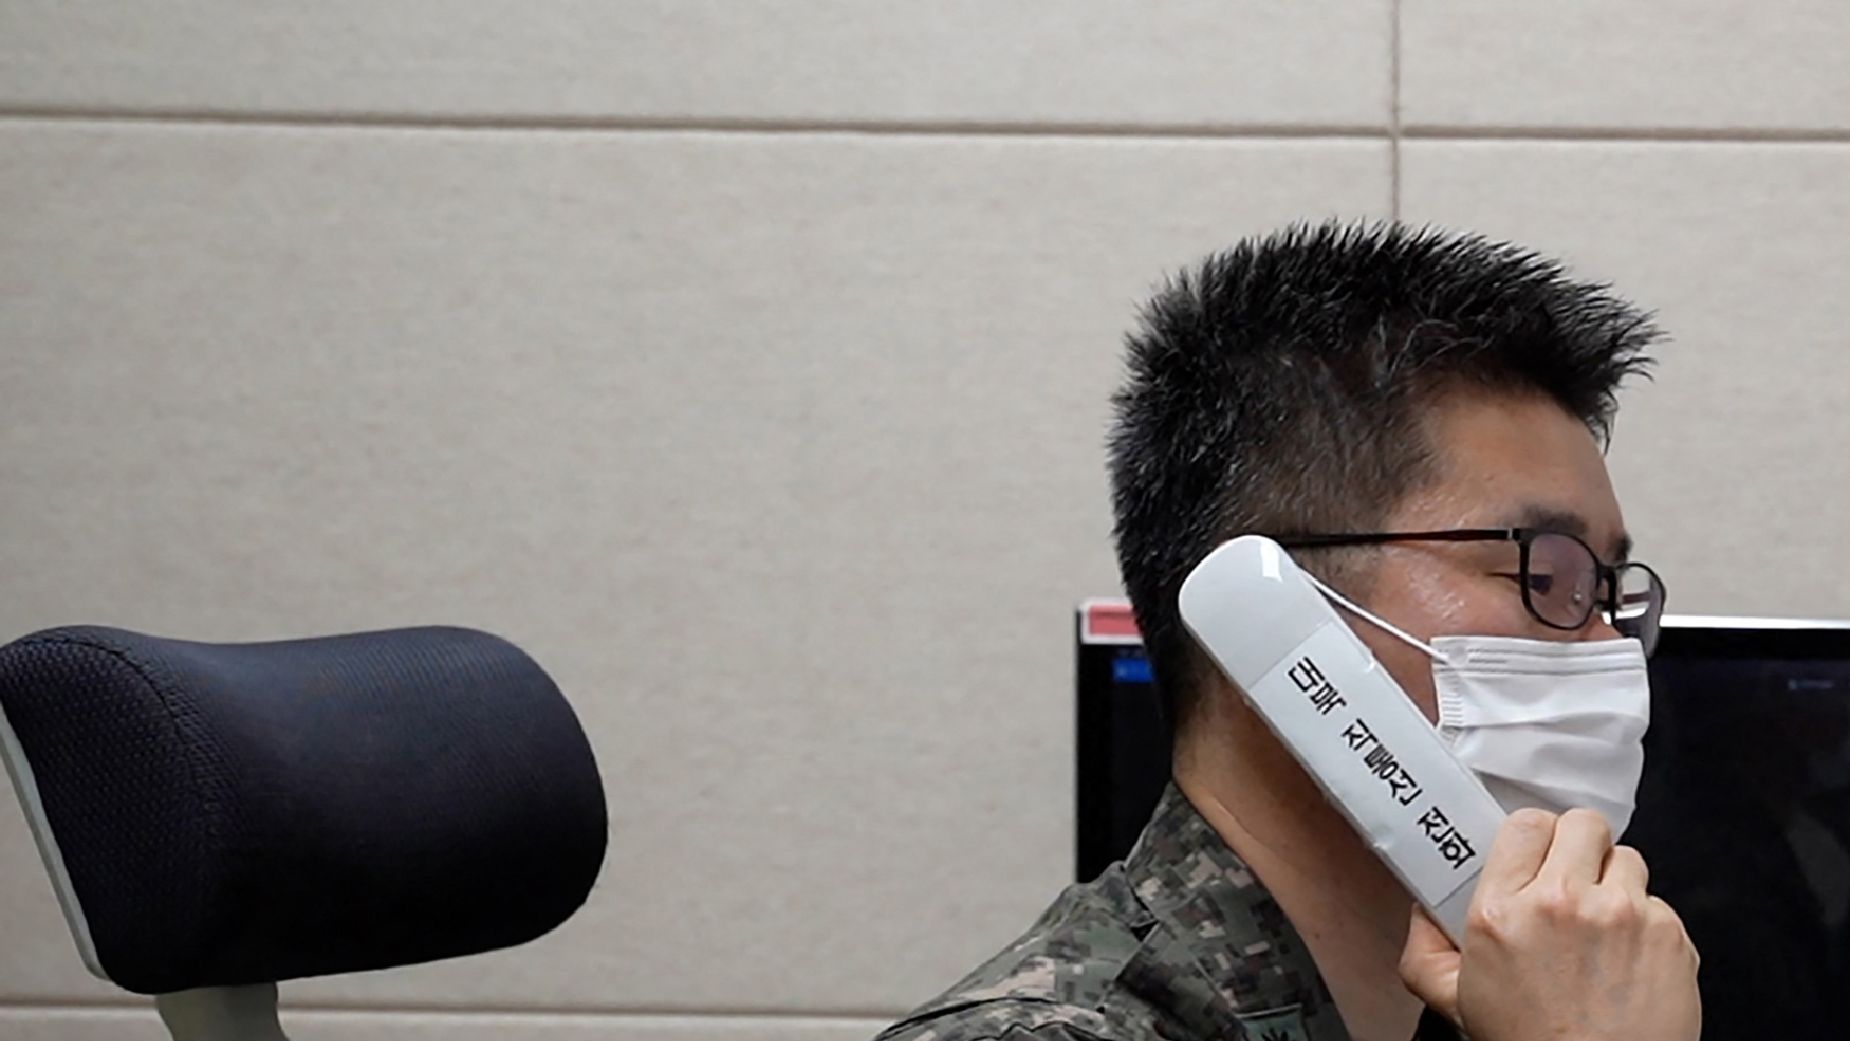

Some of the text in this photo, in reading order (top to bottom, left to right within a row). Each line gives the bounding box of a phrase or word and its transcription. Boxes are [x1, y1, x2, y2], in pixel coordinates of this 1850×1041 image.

[1287, 656, 1476, 869] 대북 직통선 전화
